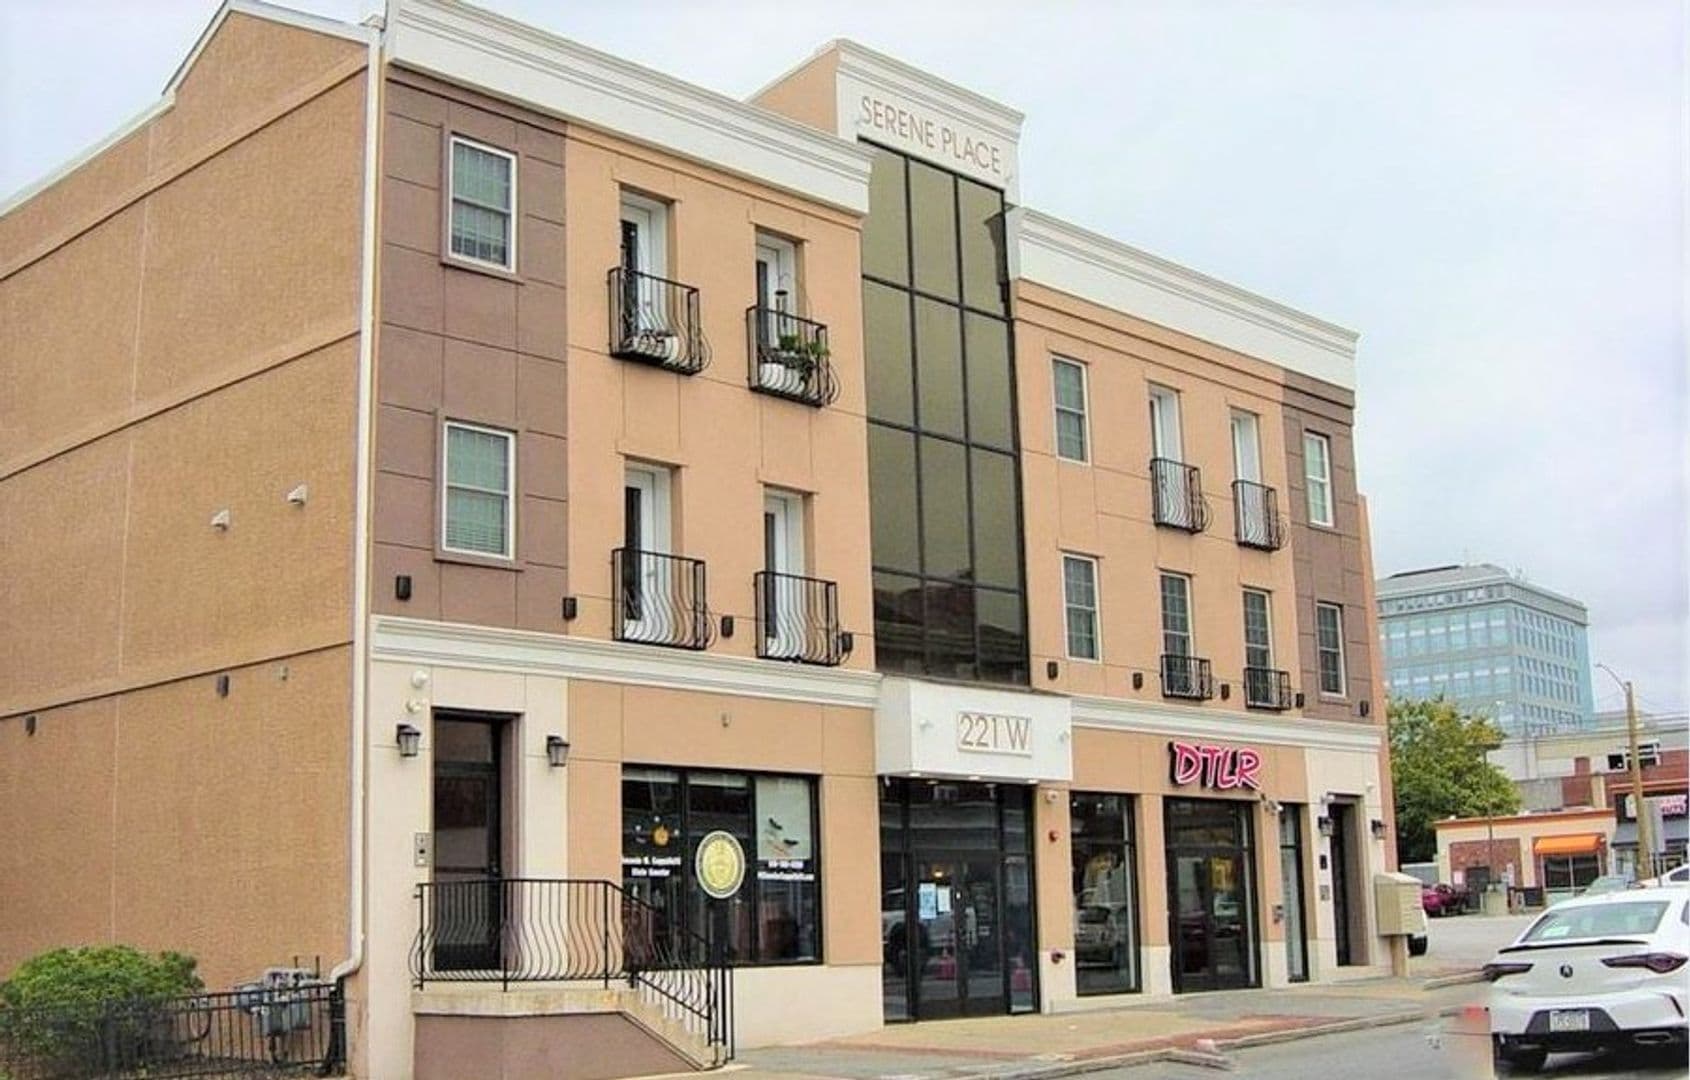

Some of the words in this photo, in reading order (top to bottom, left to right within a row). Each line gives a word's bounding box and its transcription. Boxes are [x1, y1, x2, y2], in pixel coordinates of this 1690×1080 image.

[862, 96, 934, 148] SERENE
[941, 127, 1000, 174] PLACE
[960, 714, 998, 748] 221
[1005, 717, 1029, 750] W
[1172, 742, 1261, 790] DTLR
